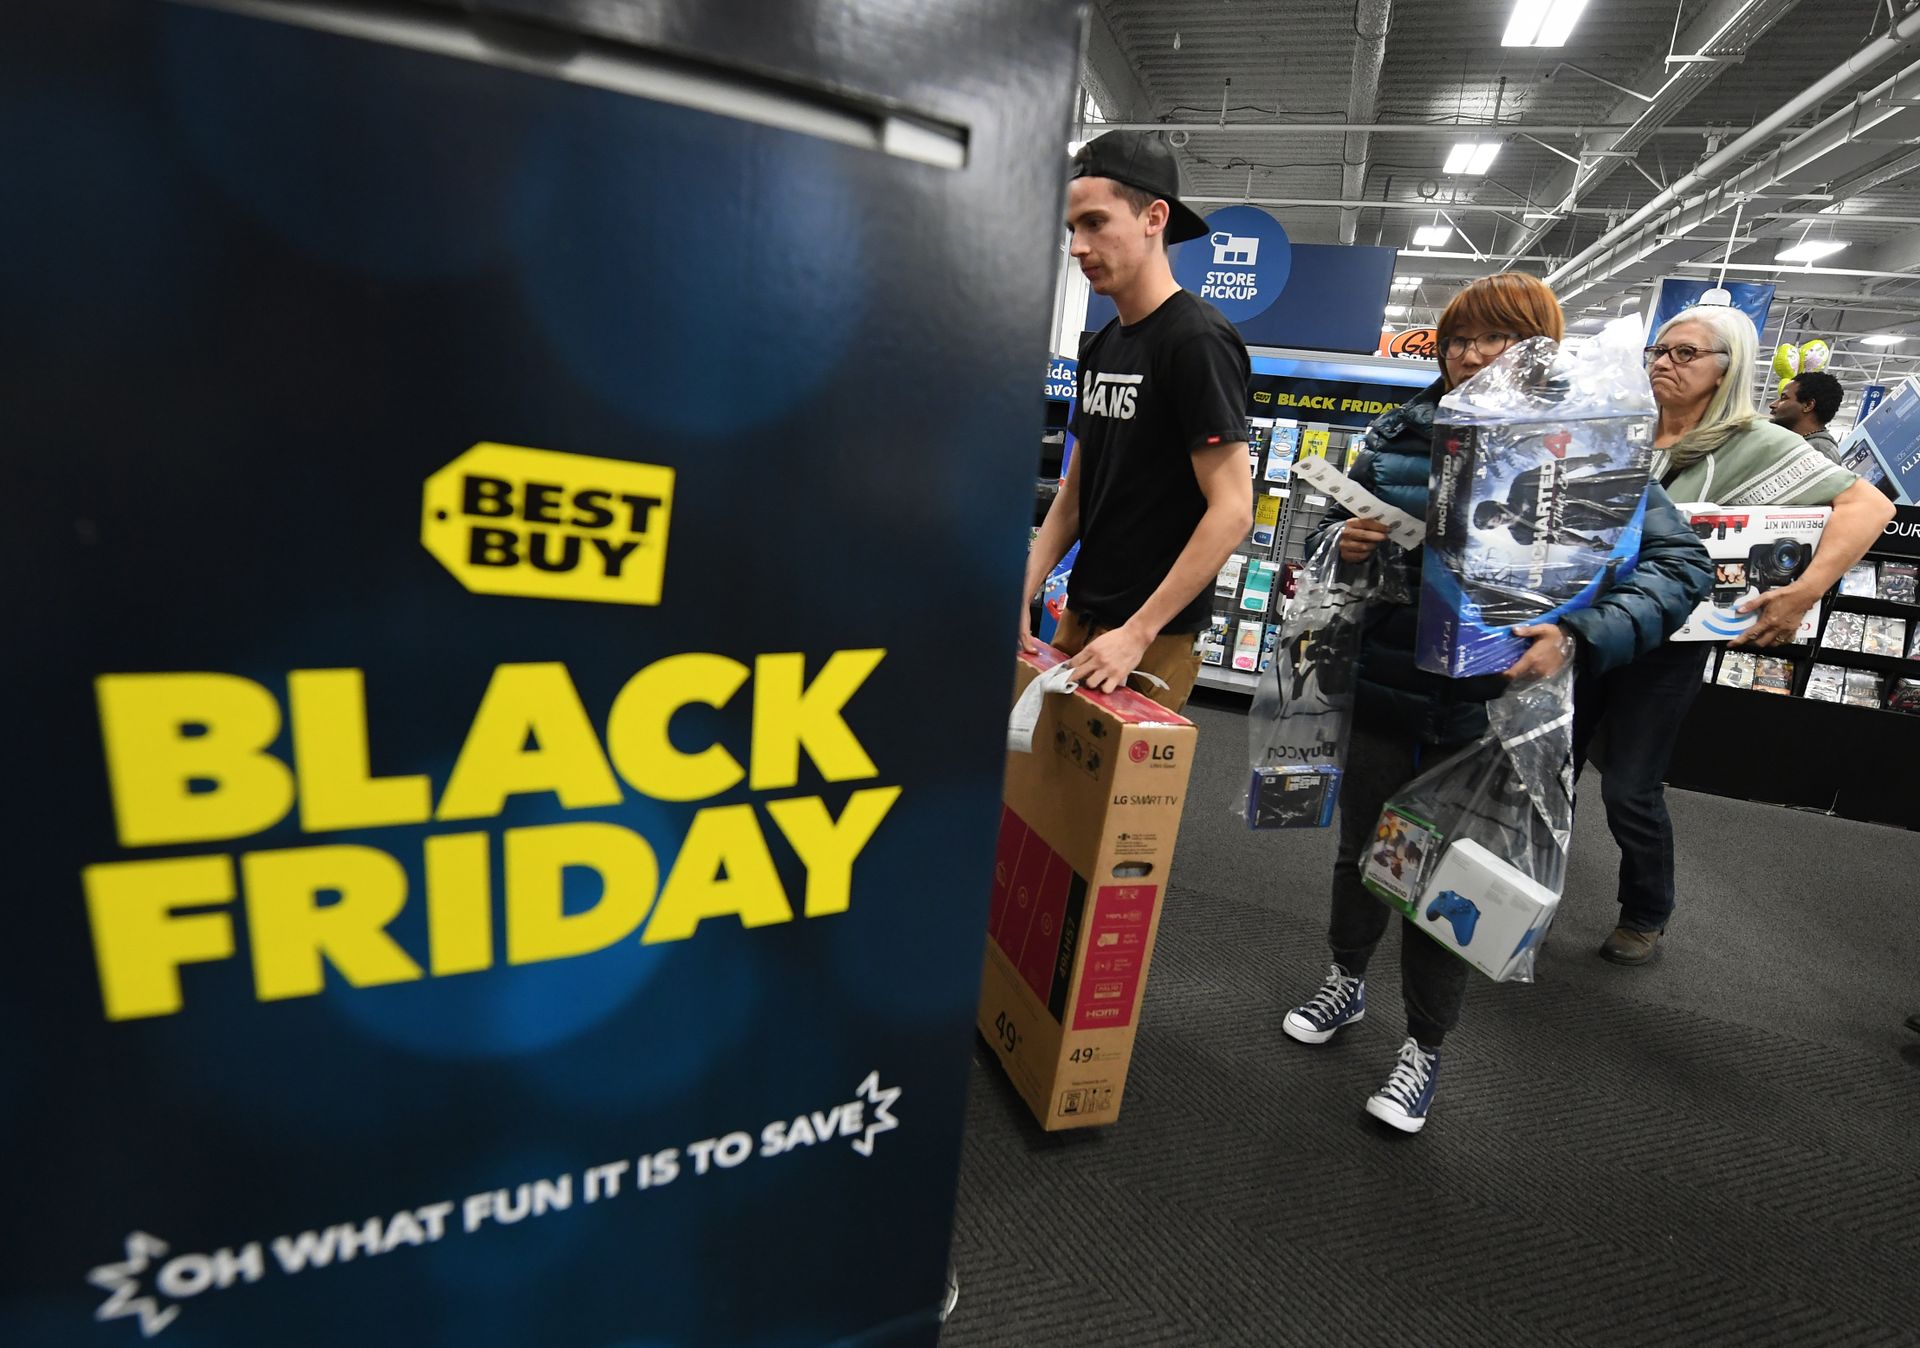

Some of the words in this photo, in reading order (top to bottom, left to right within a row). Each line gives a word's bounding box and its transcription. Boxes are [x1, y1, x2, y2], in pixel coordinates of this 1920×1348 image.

[1204, 271, 1256, 286] STORE
[1200, 285, 1258, 300] PICKUP
[1082, 369, 1144, 420] VANS
[1277, 393, 1337, 410] BLACK
[1900, 461, 1914, 475] TV
[1437, 453, 1453, 537] UNCHARTED
[460, 472, 663, 536] BEST
[1528, 460, 1556, 589] UNCHARTED
[1543, 430, 1573, 458] 4
[1764, 520, 1778, 530] KIT
[1780, 519, 1824, 530] PREMIUM
[466, 526, 646, 579] BUY
[94, 647, 887, 847] BLACK
[1152, 744, 1175, 760] LG
[1113, 795, 1129, 805] LG
[1130, 794, 1164, 806] SMART
[1165, 795, 1179, 805] TV
[80, 785, 903, 1022] FRIDAY
[1086, 1007, 1120, 1018] HDMI
[157, 1243, 264, 1298] OH
[272, 1202, 454, 1276] WHAT
[463, 1174, 572, 1232] FUN
[583, 1160, 629, 1202] IT
[637, 1148, 680, 1189] IS
[687, 1132, 753, 1174] TO
[760, 1100, 864, 1158] SAVE
